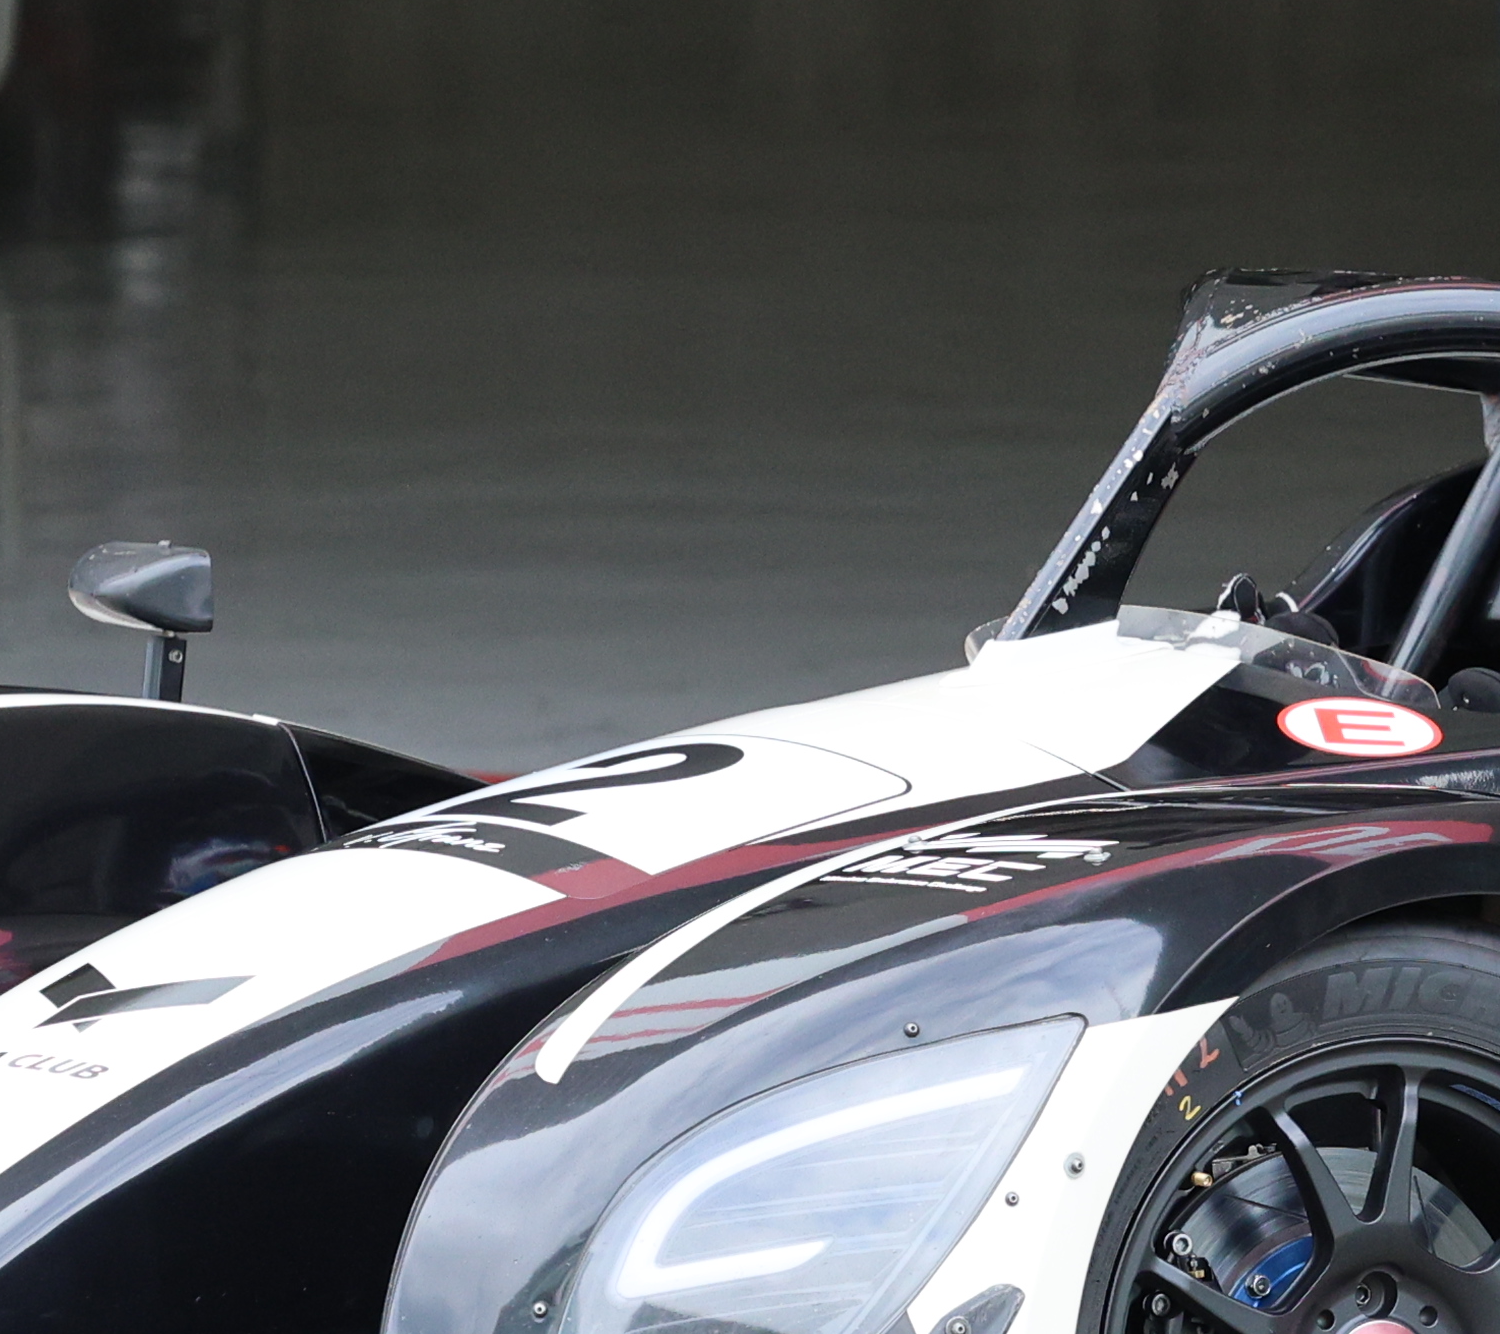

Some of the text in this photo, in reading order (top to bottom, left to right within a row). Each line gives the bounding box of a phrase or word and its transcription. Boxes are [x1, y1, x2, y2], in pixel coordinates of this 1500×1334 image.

[1312, 707, 1406, 747] E
[422, 742, 745, 827] 2
[841, 854, 1047, 883] MEC
[7, 1053, 110, 1079] CLUB
[1178, 1095, 1202, 1121] 2
